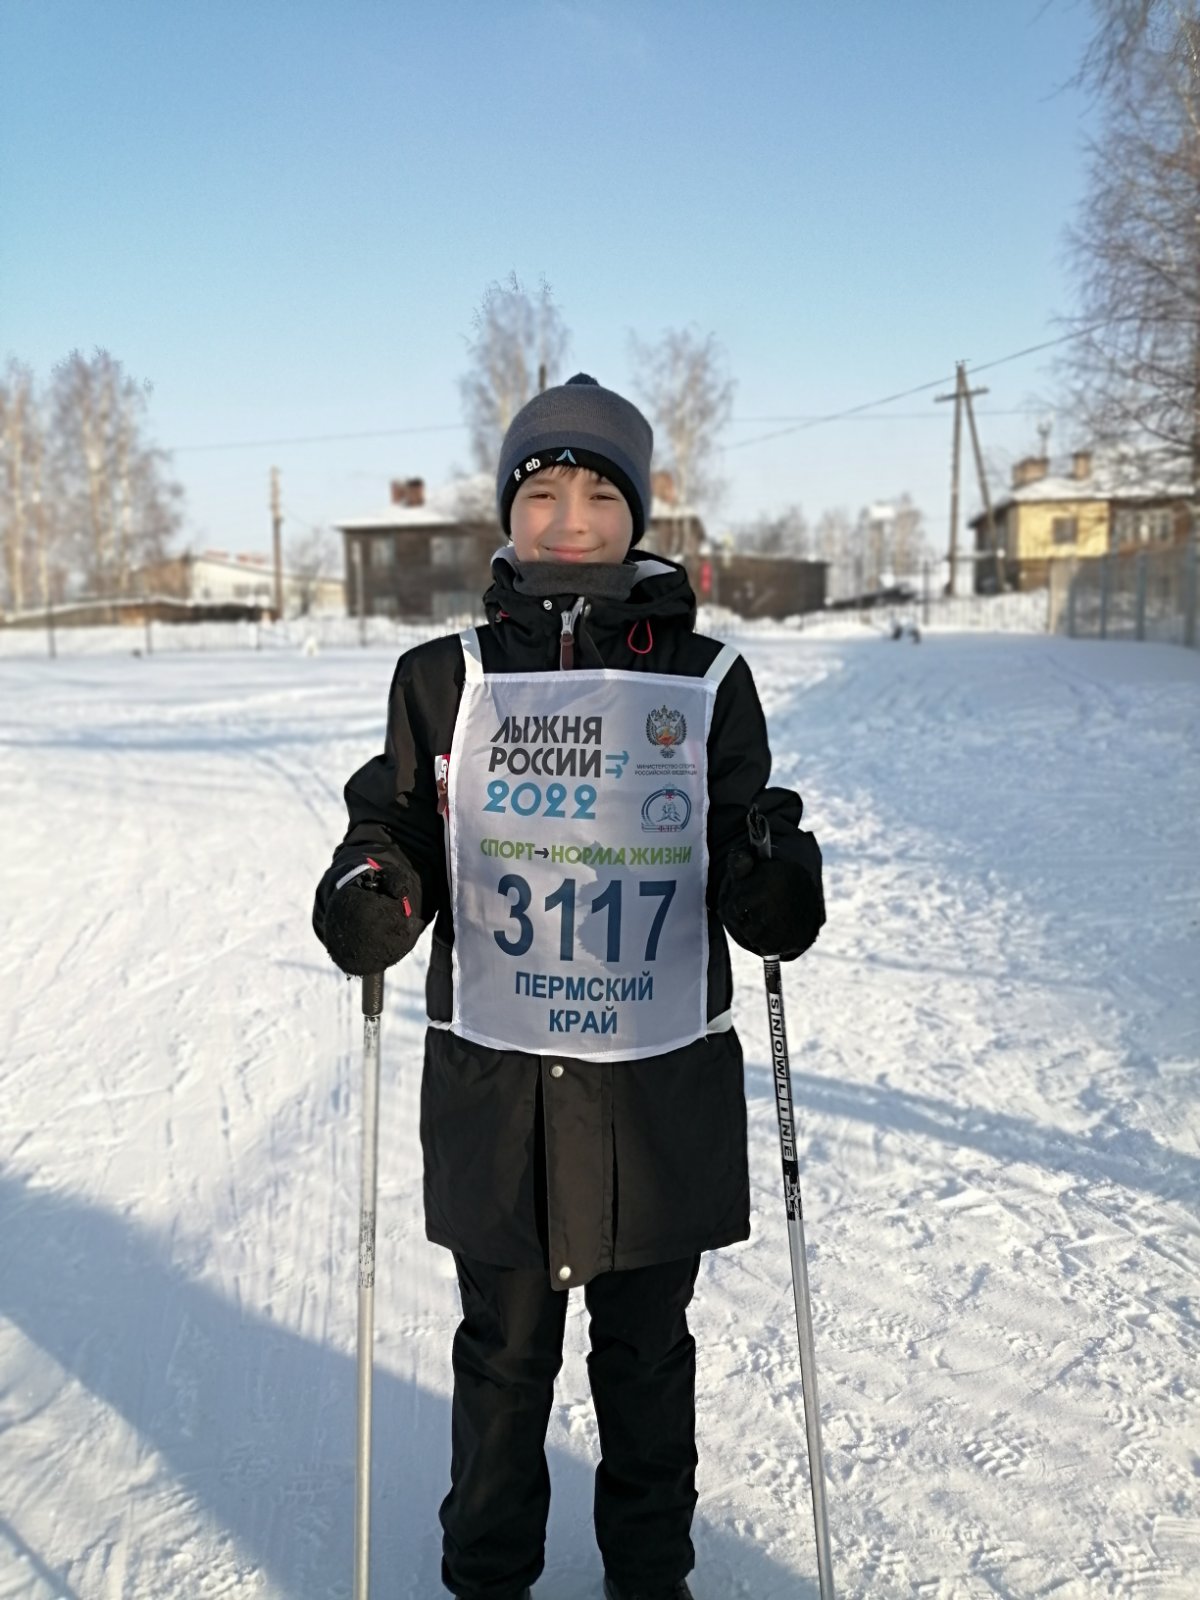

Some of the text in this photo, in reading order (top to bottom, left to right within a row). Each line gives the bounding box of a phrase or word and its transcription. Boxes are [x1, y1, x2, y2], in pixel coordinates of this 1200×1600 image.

[490, 715, 602, 745] ЛЫЖНЯ
[488, 747, 602, 777] РОССИИ
[482, 780, 597, 819] 2022
[480, 839, 692, 865] СПОРТ НОРМА ЖИЗНИ
[493, 873, 677, 962] 3117
[515, 970, 653, 1001] ПЕРМСКИЙ
[549, 1005, 618, 1034] КРАЙ
[770, 998, 793, 1157] SNOWLINE
